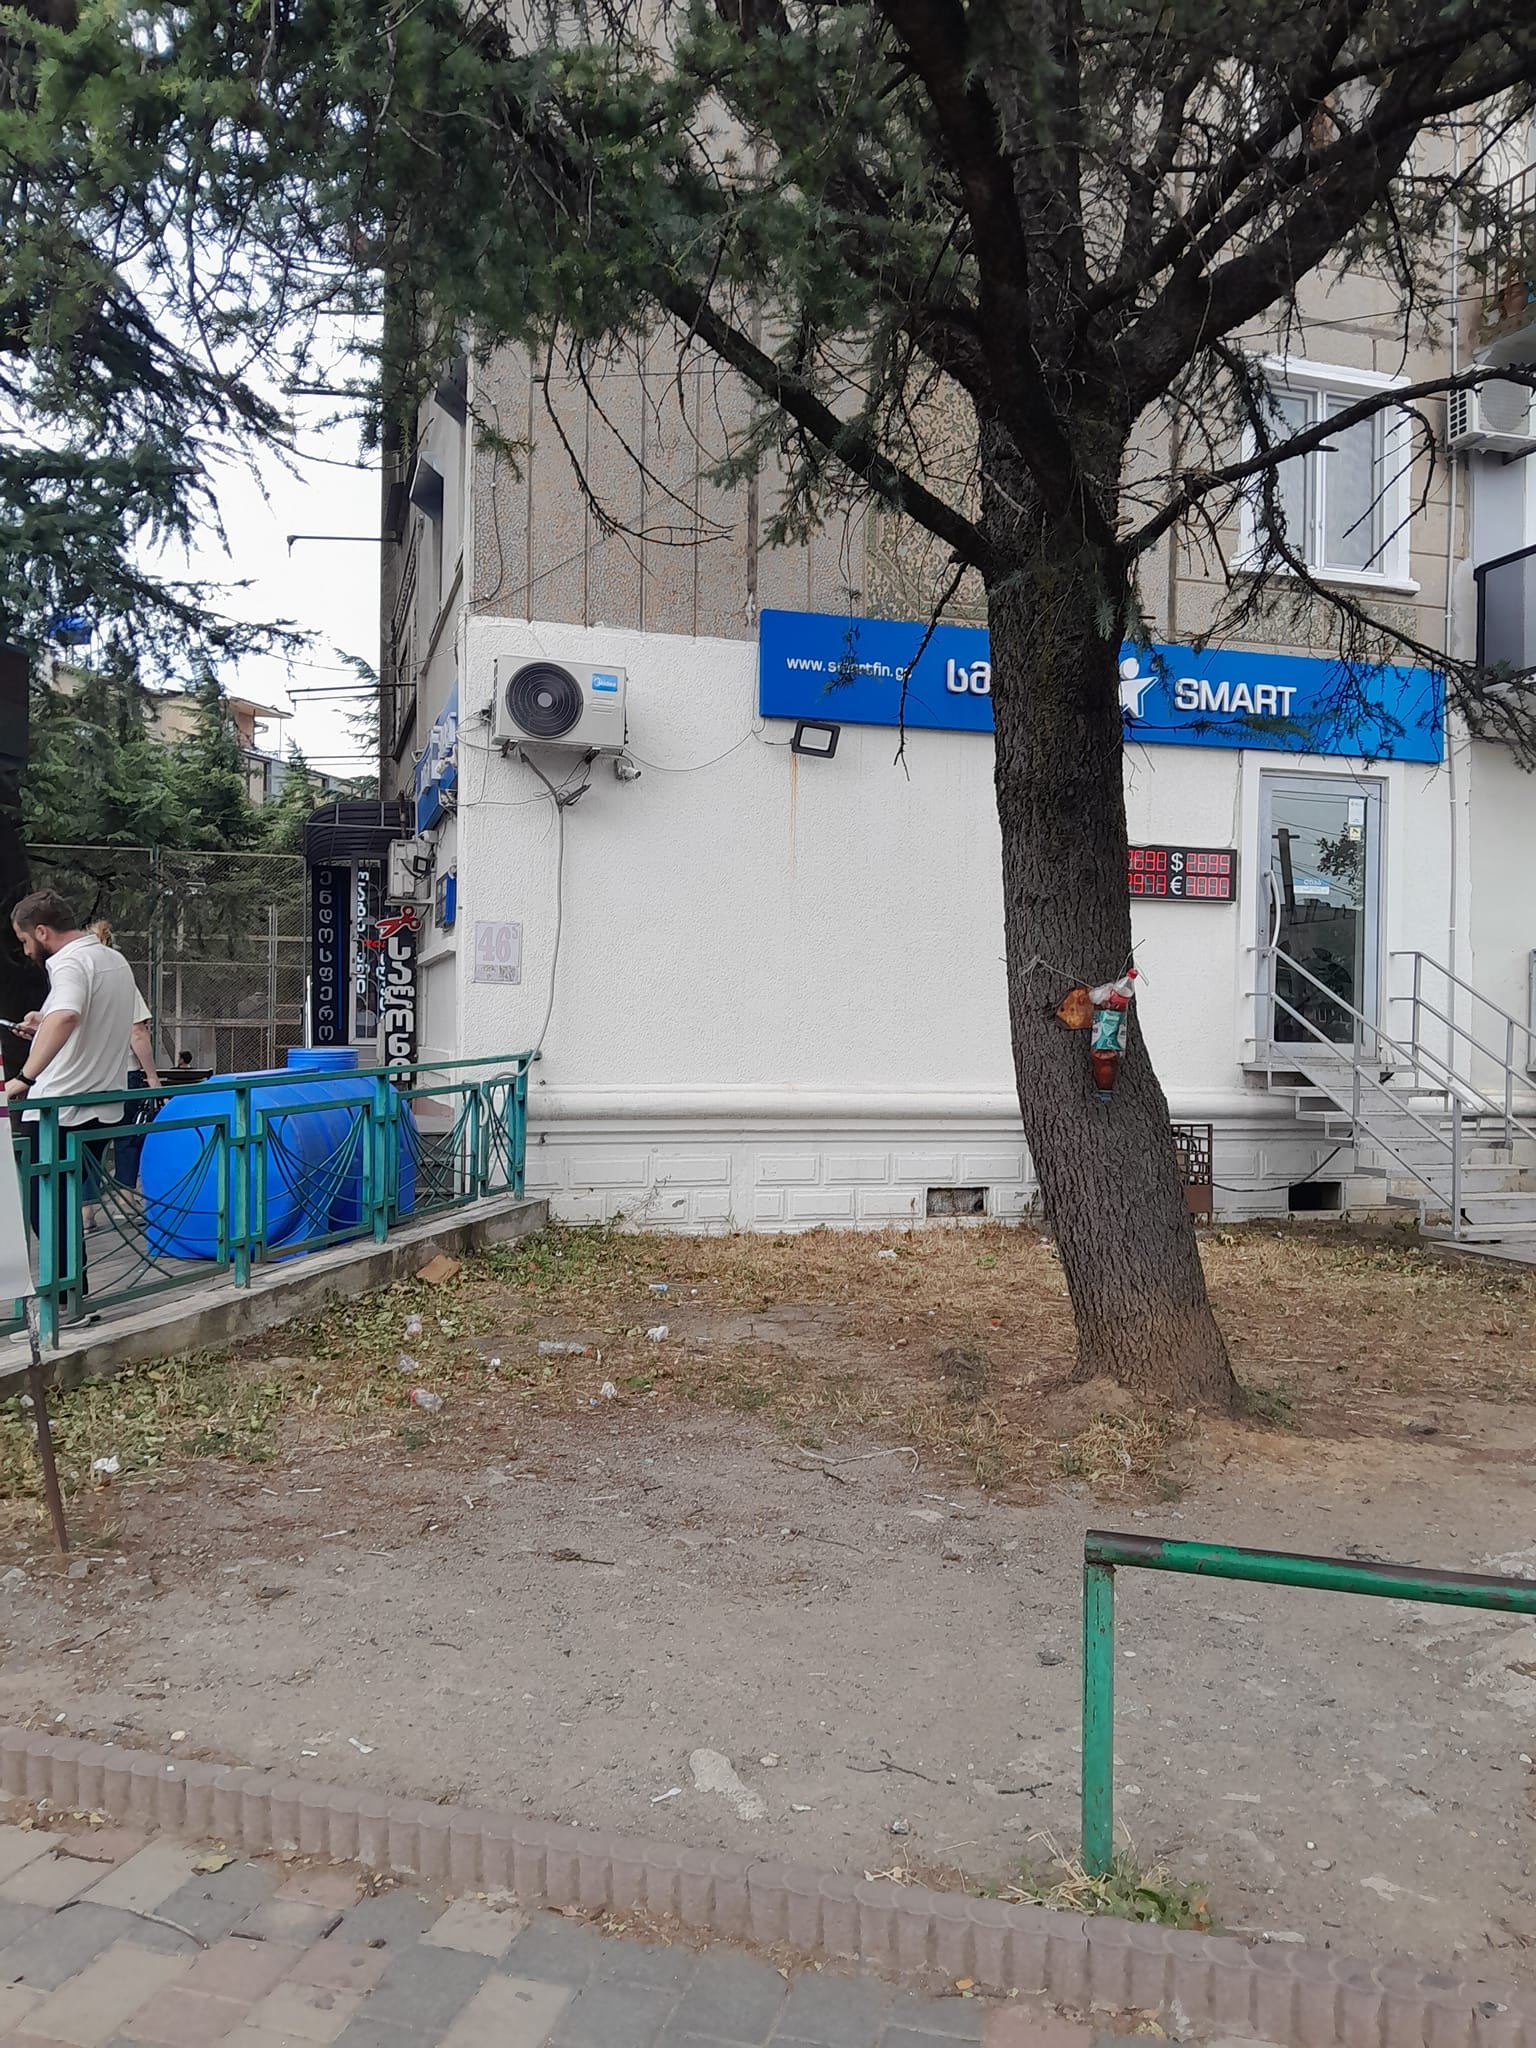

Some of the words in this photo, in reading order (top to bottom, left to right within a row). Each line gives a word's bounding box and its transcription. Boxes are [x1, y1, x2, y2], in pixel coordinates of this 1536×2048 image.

[1174, 677, 1298, 716] SMART
[1170, 852, 1184, 873] $
[1169, 876, 1183, 895] €
